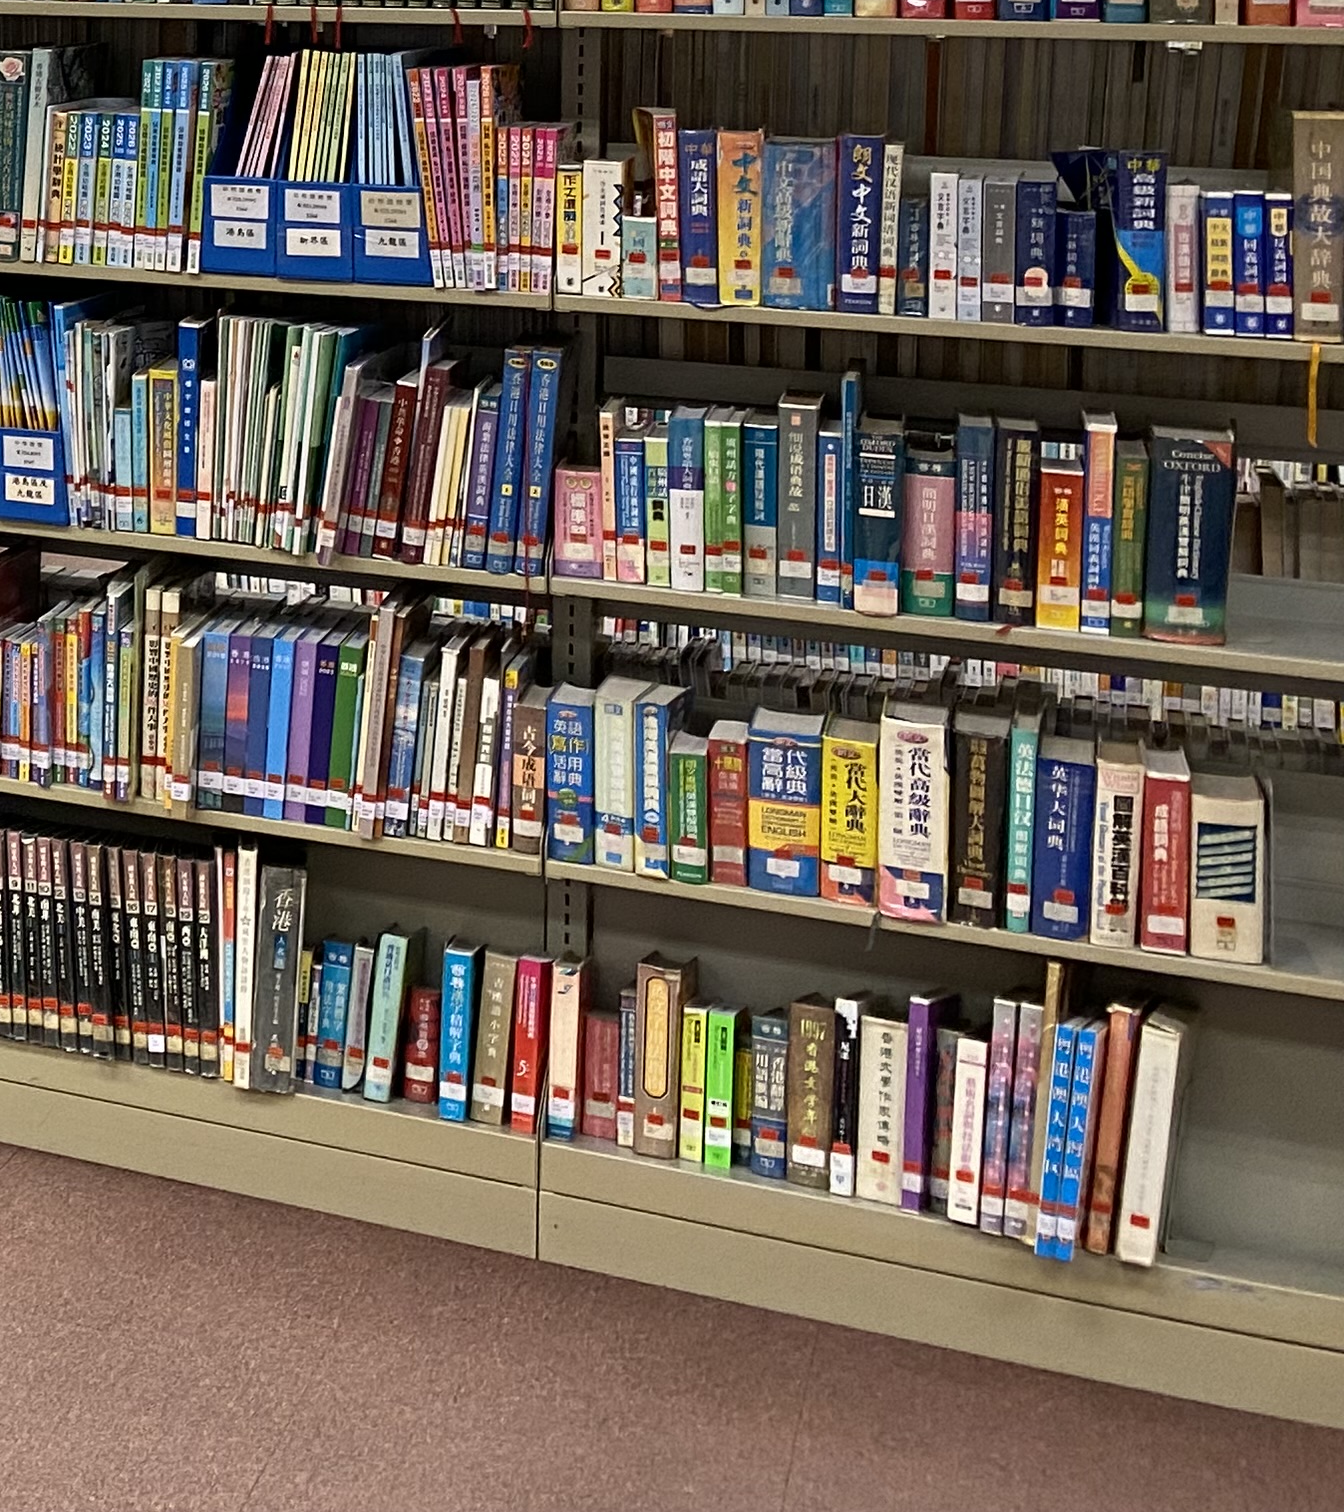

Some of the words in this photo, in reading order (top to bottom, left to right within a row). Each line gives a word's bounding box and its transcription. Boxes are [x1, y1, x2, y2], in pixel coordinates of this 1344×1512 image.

[690, 159, 709, 217] 成語大詞典
[1171, 449, 1215, 461] Concise
[1163, 461, 1221, 473] OXFORD
[862, 485, 893, 511] 日漢
[553, 719, 582, 736] 英語
[845, 762, 867, 835] 當代大辭典
[908, 747, 932, 839] 當代高級辭典
[762, 807, 807, 818] LONGMAN
[761, 826, 807, 838] ENGLISH
[272, 889, 293, 932] 香港
[800, 1018, 826, 1041] 1997
